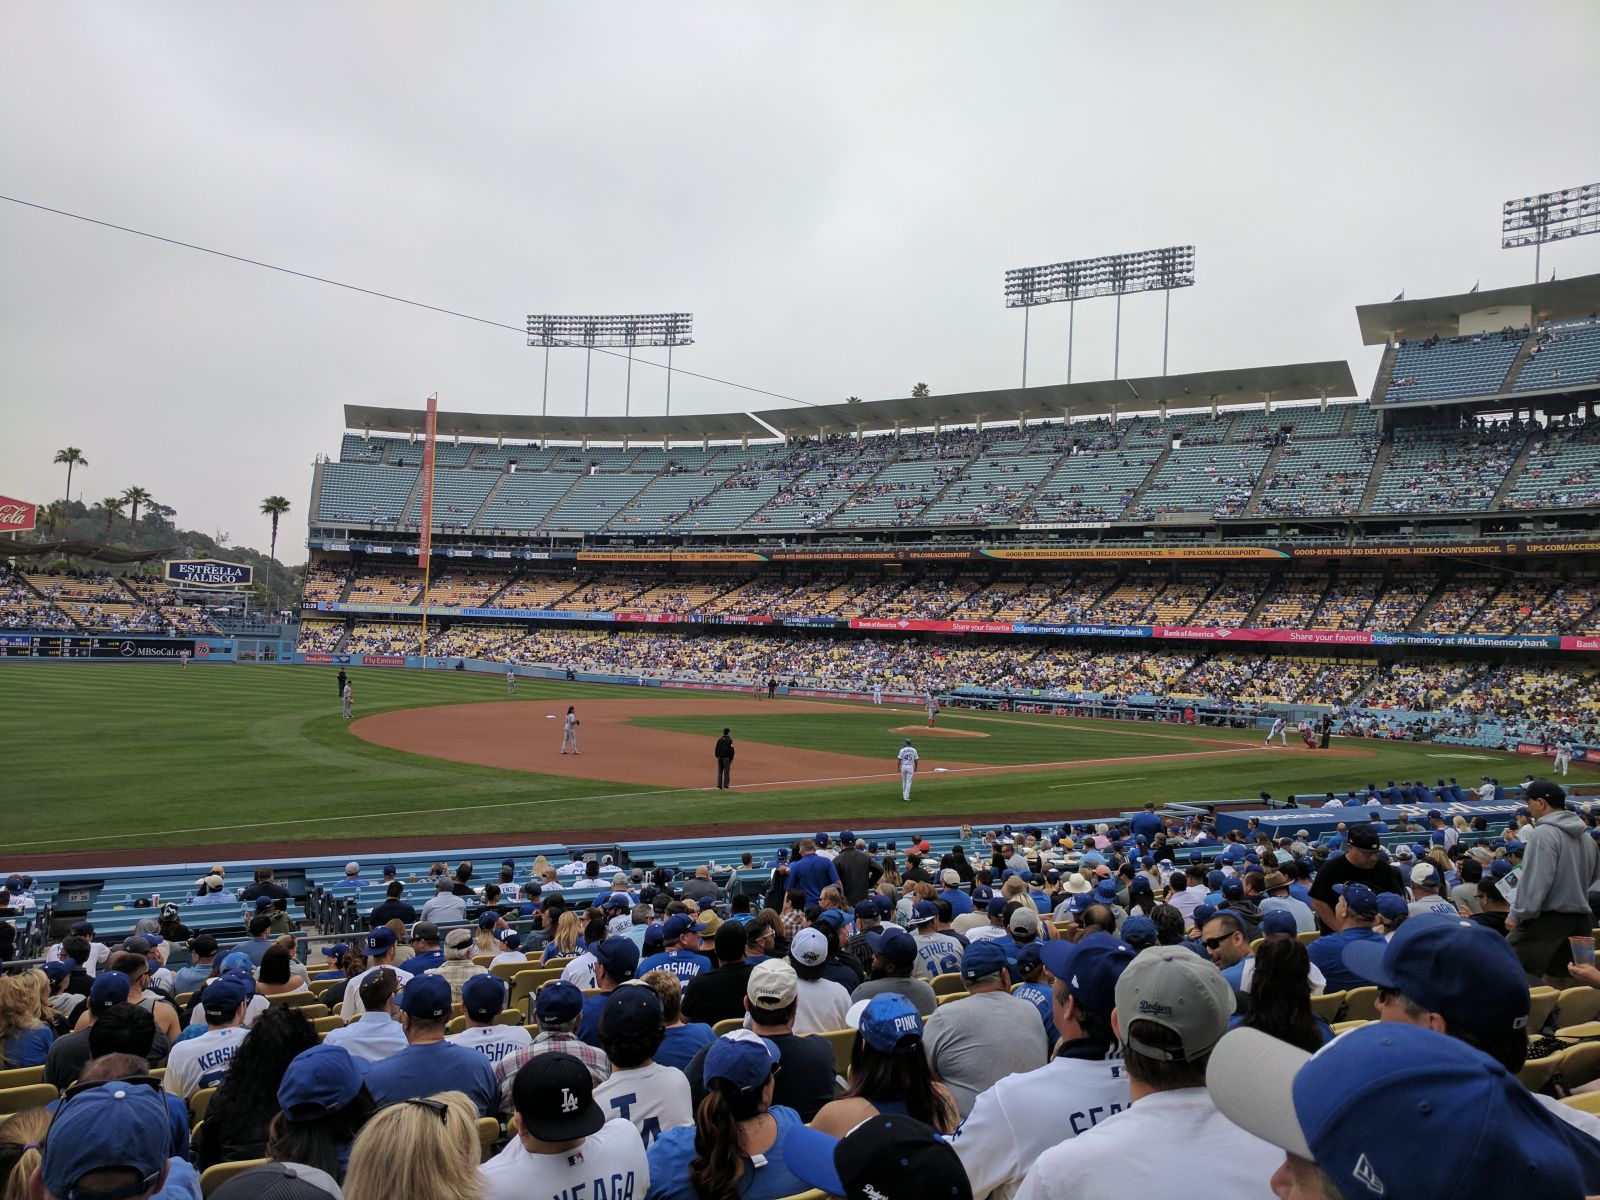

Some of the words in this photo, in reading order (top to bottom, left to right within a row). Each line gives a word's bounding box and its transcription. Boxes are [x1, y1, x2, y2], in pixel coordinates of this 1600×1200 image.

[0, 504, 29, 524] ola
[442, 528, 506, 536] STADIUM
[179, 564, 242, 576] ESTRELLA
[185, 573, 236, 583] JALISCO
[302, 600, 317, 608] 12:20
[1011, 625, 1037, 633] Dodgers
[1076, 628, 1143, 636] #MLBmemorybank
[1370, 635, 1405, 644] Dodgers
[1408, 636, 1442, 646] memory
[1457, 638, 1548, 648] #MLBmemorybank
[370, 938, 376, 947] B
[918, 942, 954, 960] ETHIER
[1140, 1000, 1172, 1015] Dodgers
[895, 1016, 918, 1032] PINK
[561, 1088, 578, 1112] LA
